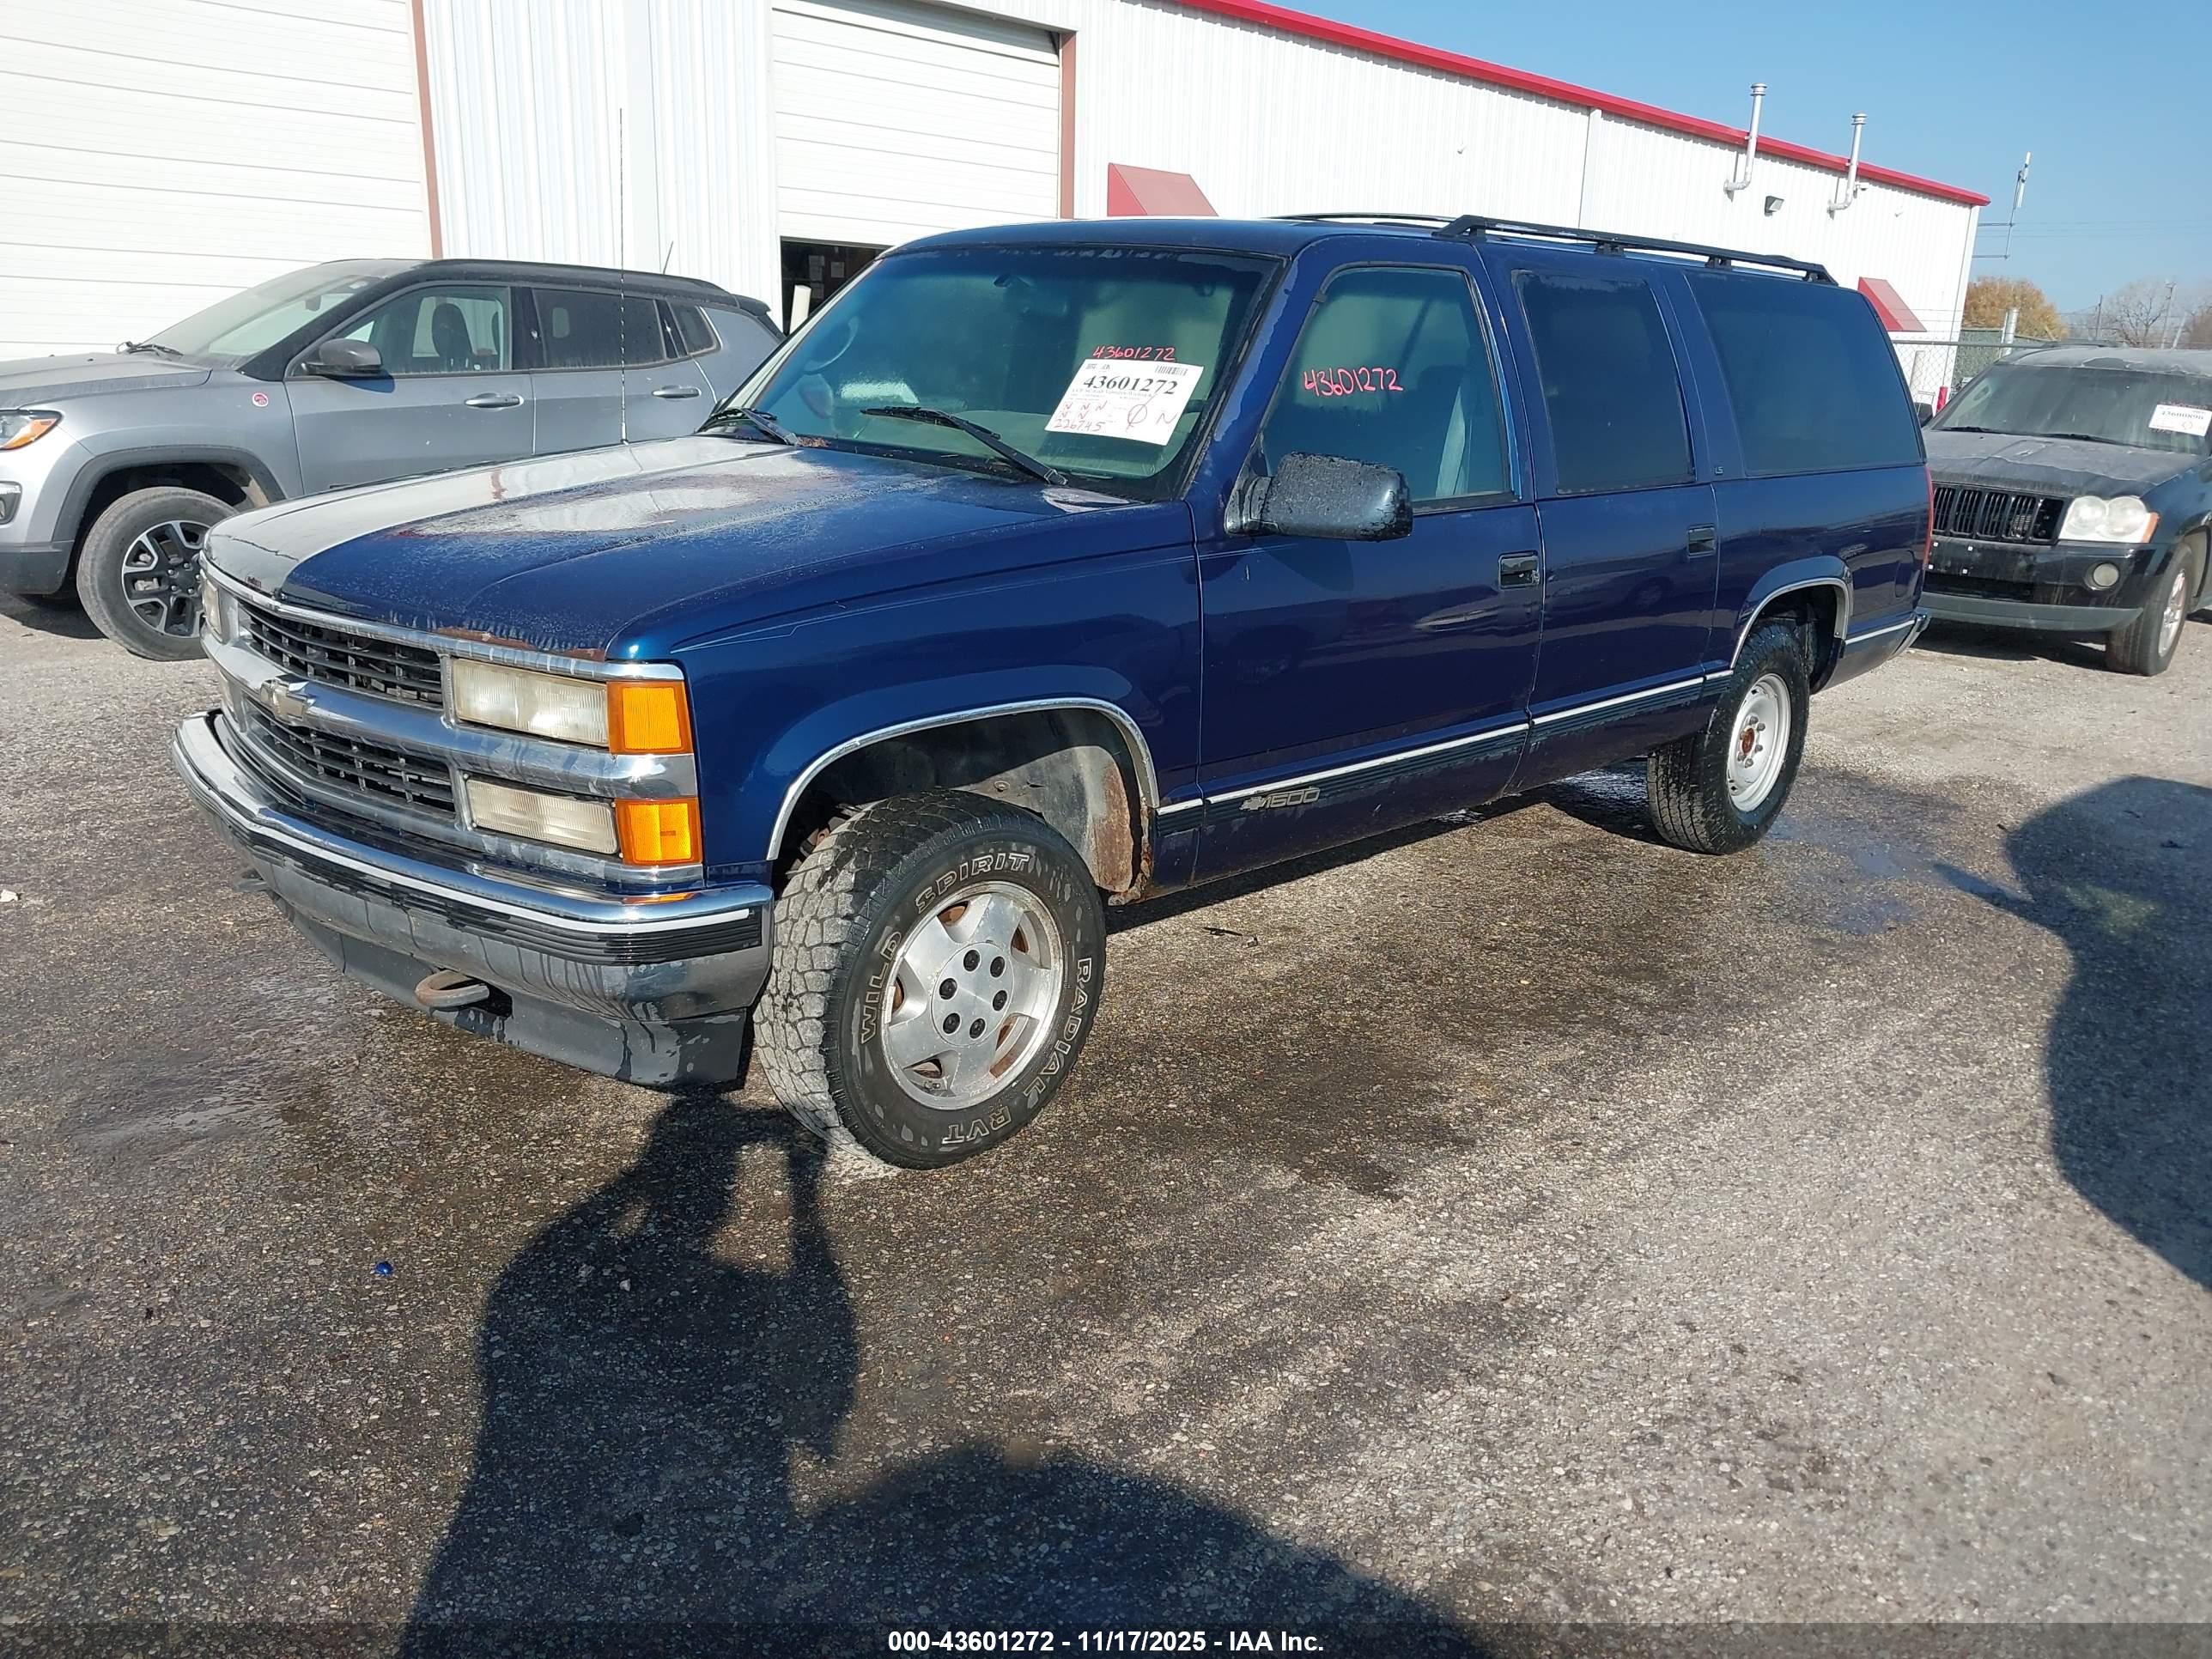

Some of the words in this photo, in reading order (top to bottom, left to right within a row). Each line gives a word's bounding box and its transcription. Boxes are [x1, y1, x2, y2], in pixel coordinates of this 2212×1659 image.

[1092, 345, 1176, 362] 43601272
[1083, 374, 1178, 395] 43601272
[1303, 367, 1404, 397] 43601272
[860, 930, 902, 1044] WILD
[915, 852, 1030, 915] SPIRIT
[1023, 957, 1092, 1098] RADIAL
[941, 1105, 1012, 1145] RVT
